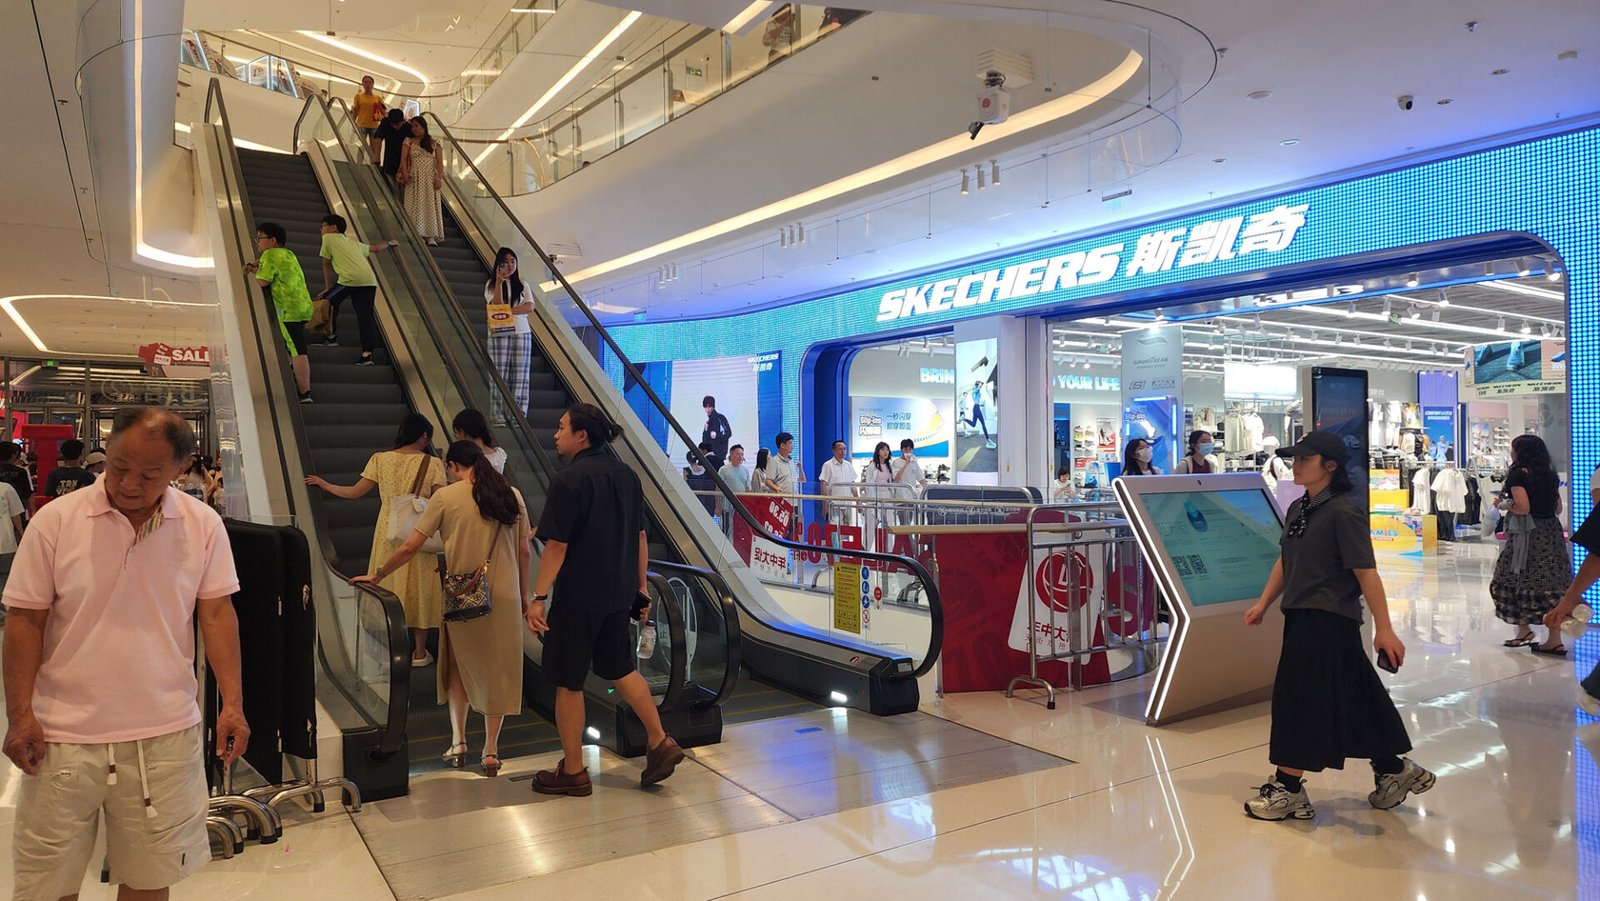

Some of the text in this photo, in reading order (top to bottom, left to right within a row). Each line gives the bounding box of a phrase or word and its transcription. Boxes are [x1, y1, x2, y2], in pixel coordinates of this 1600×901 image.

[877, 203, 1310, 321] SKECHERS 斯凯奇
[1058, 375, 1093, 390] YOUR
[1095, 377, 1121, 391] LIFE
